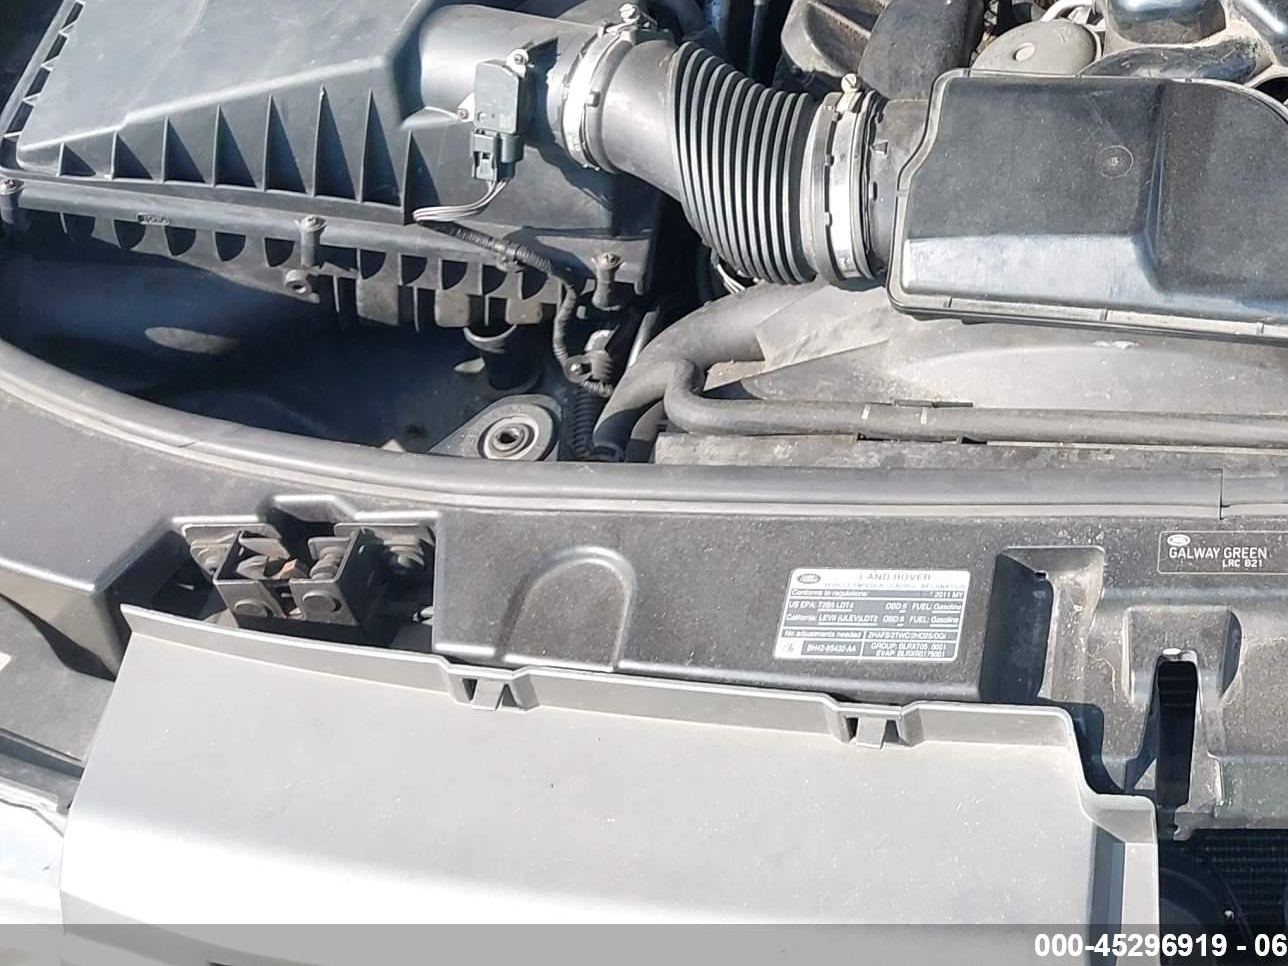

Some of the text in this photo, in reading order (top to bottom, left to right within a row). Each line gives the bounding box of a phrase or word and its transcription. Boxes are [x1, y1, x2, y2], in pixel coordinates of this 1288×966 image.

[1169, 546, 1267, 559] GALWAY GREEN
[1222, 559, 1263, 568] LRC 821
[859, 573, 931, 581] LAND ROVER
